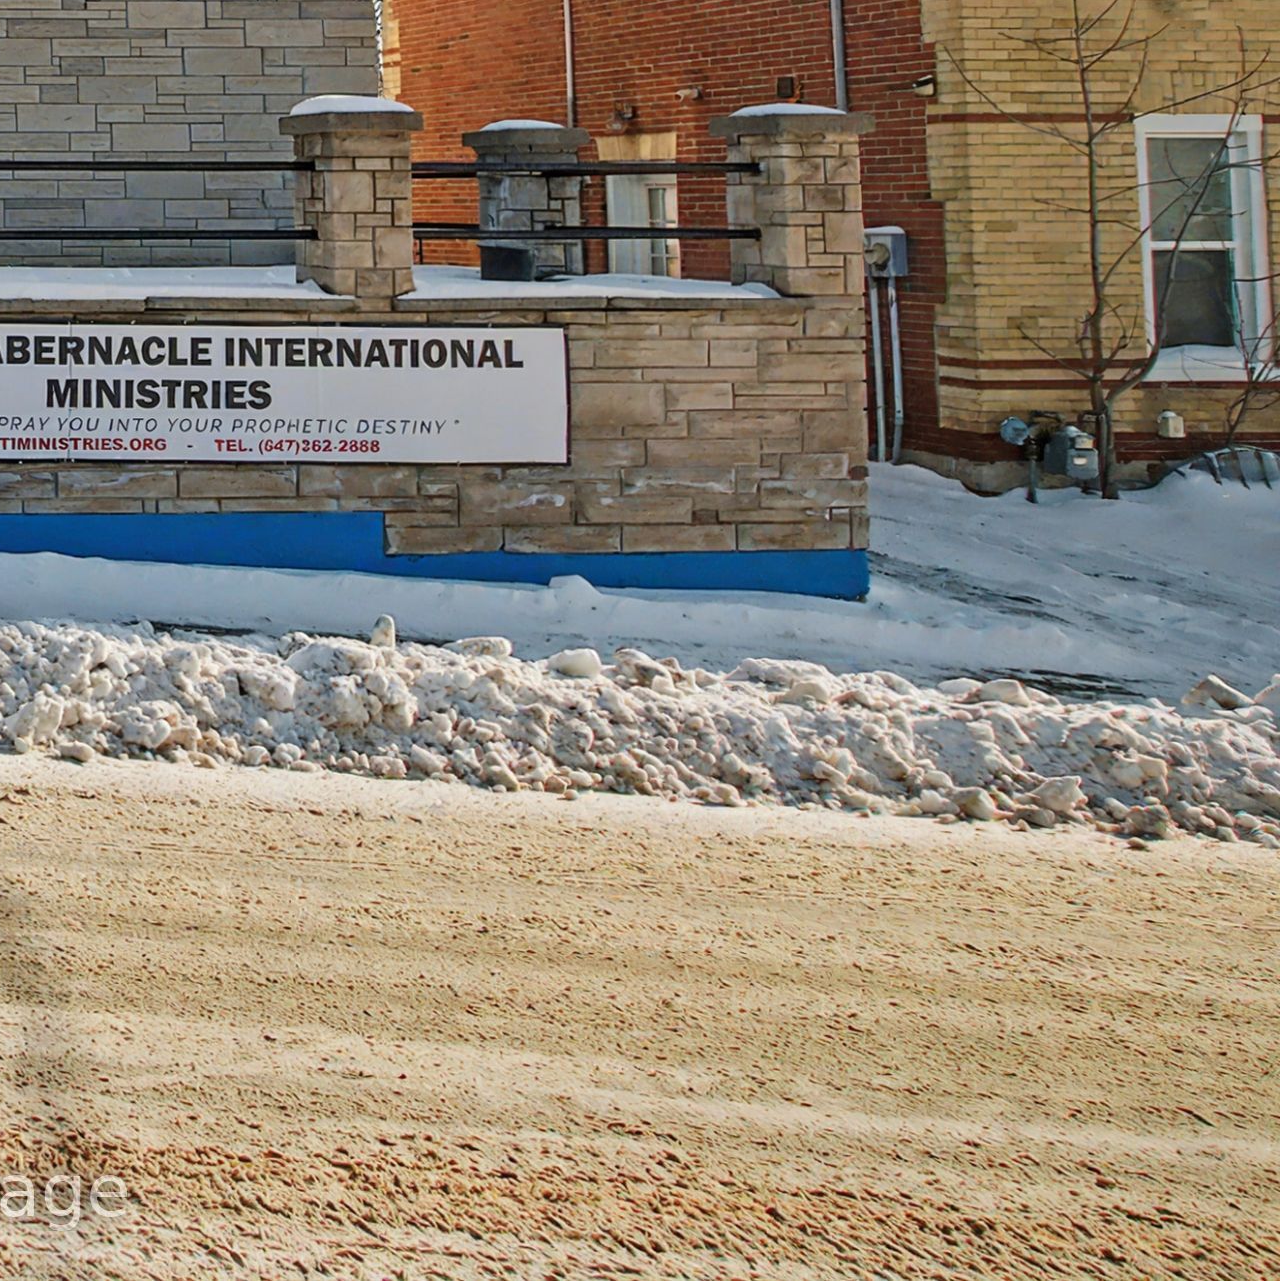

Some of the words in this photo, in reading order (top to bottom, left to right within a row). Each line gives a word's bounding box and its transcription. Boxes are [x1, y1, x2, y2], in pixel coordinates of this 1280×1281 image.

[225, 337, 524, 369] INTERNATIONAL
[46, 378, 272, 410] MINISTRIES
[57, 416, 100, 432] YOU
[108, 417, 158, 433] INTO
[168, 417, 223, 433] YOUR
[231, 418, 348, 435] PROPHETIC
[356, 419, 447, 435] DESTINY
[214, 438, 253, 452] TEL.
